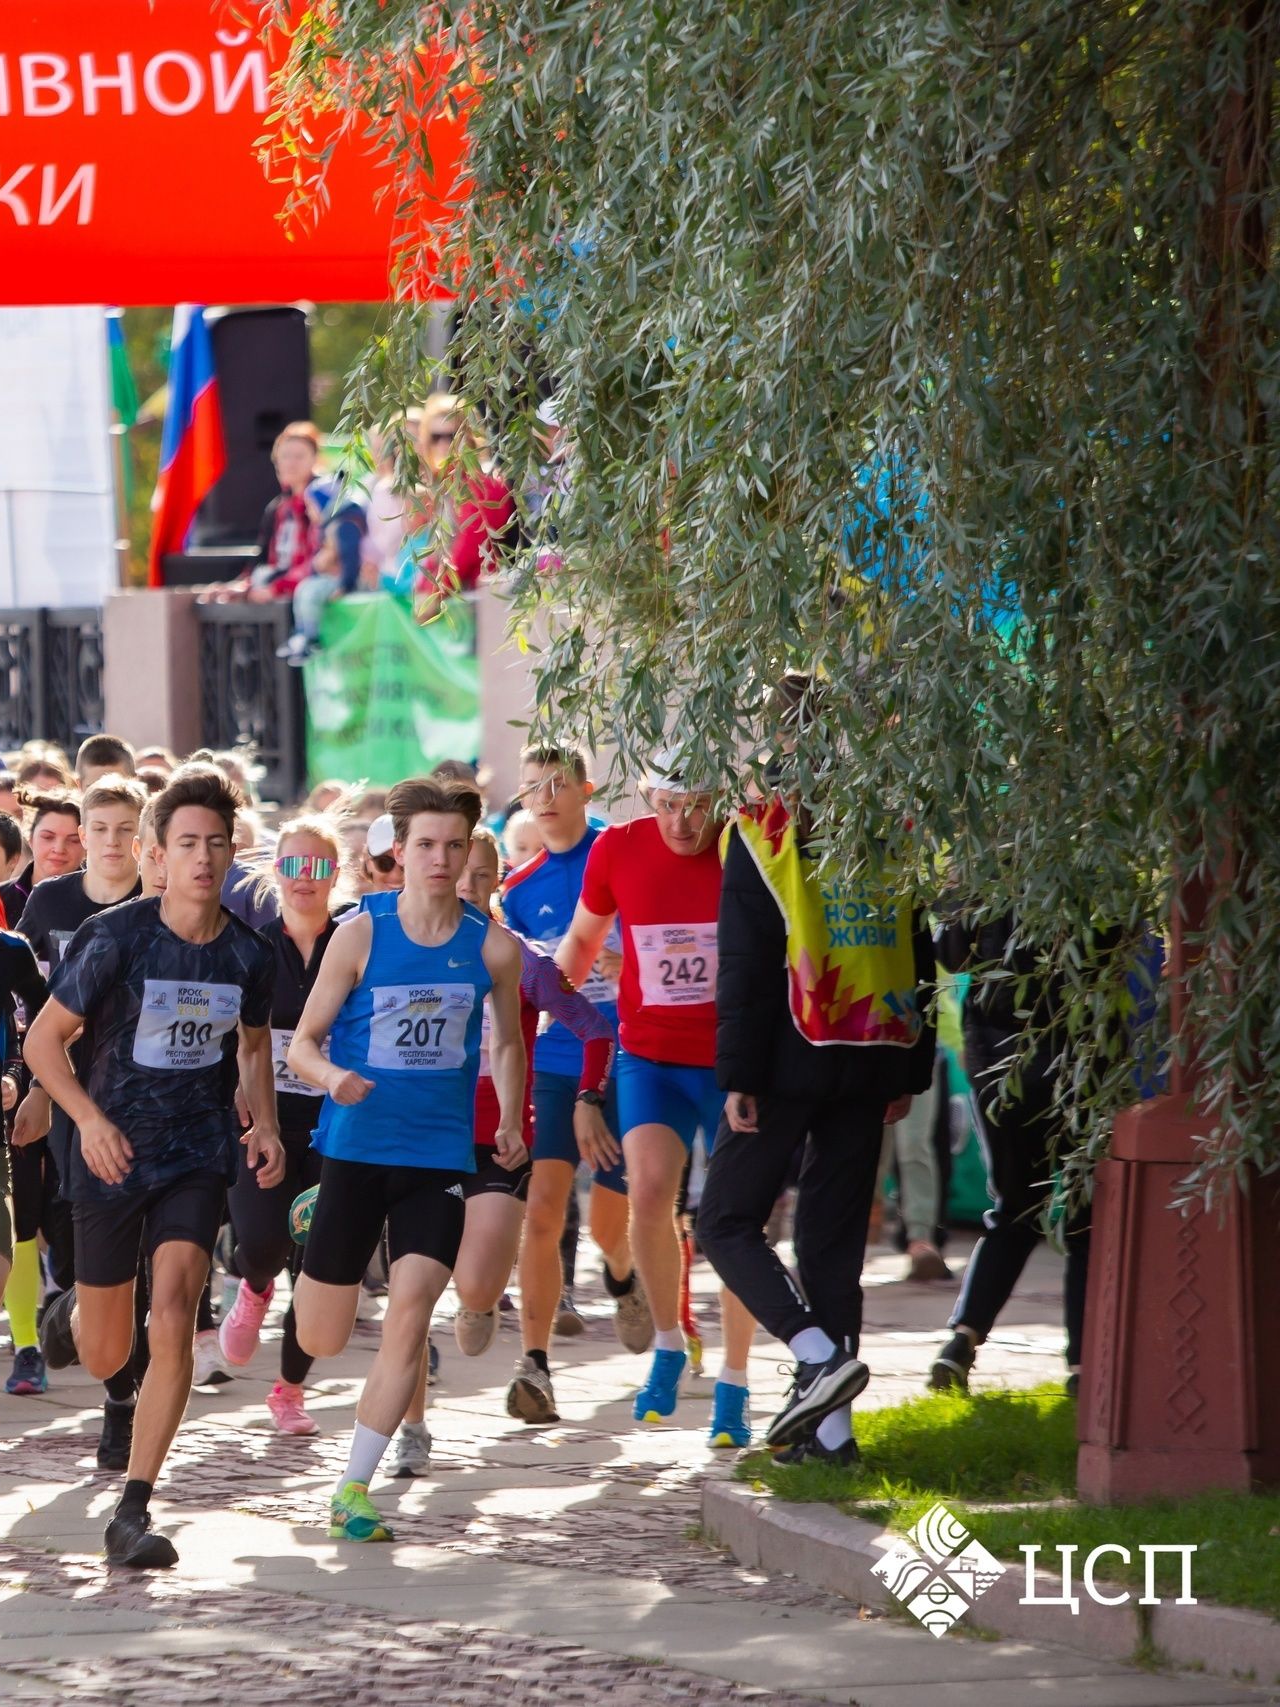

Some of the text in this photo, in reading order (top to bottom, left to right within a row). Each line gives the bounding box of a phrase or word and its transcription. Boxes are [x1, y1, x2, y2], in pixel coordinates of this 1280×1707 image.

[659, 957, 708, 985] 242
[177, 988, 202, 996] КРОСС
[409, 989, 434, 997] КРОСС
[177, 997, 209, 1006] НАЦИИ
[395, 1018, 447, 1047] 207
[399, 1050, 442, 1058] РЕСПУБЛИКА
